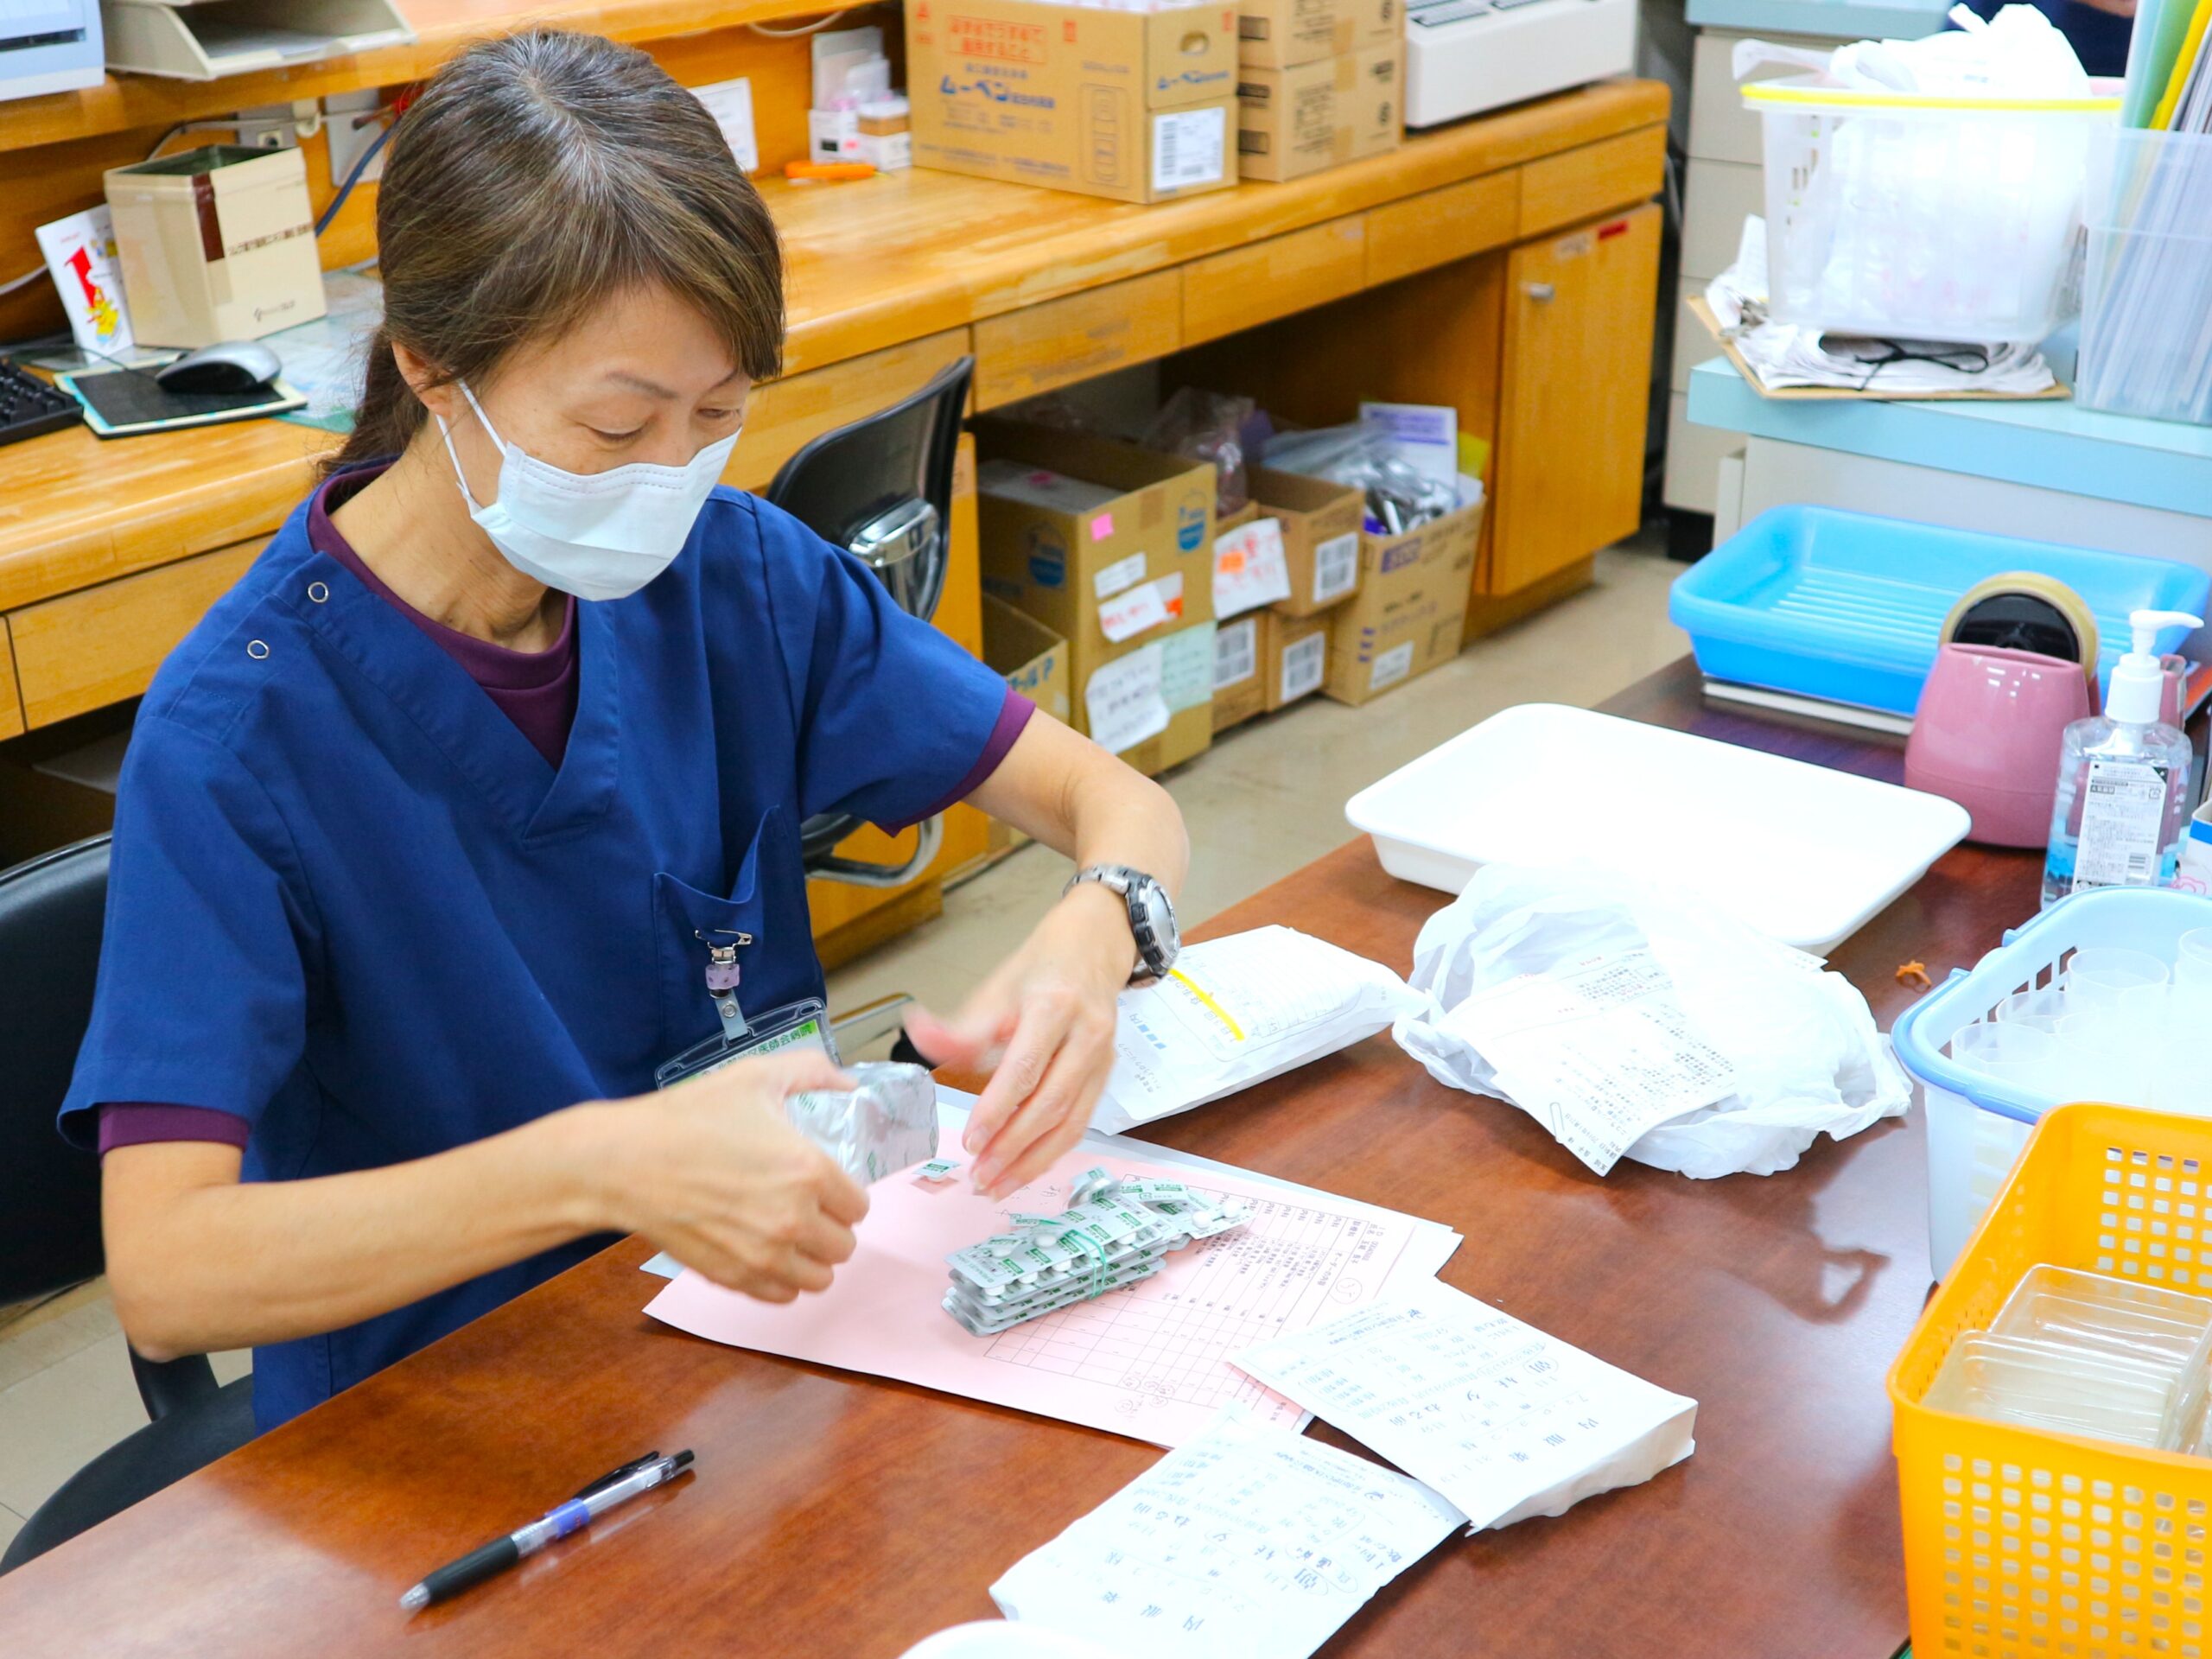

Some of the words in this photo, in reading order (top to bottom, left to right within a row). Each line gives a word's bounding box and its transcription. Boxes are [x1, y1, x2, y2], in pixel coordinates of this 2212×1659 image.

[1528, 1360, 1552, 1371] 朝
[1462, 1391, 1481, 1401] 夕
[1389, 1402, 1441, 1427] ねる前
